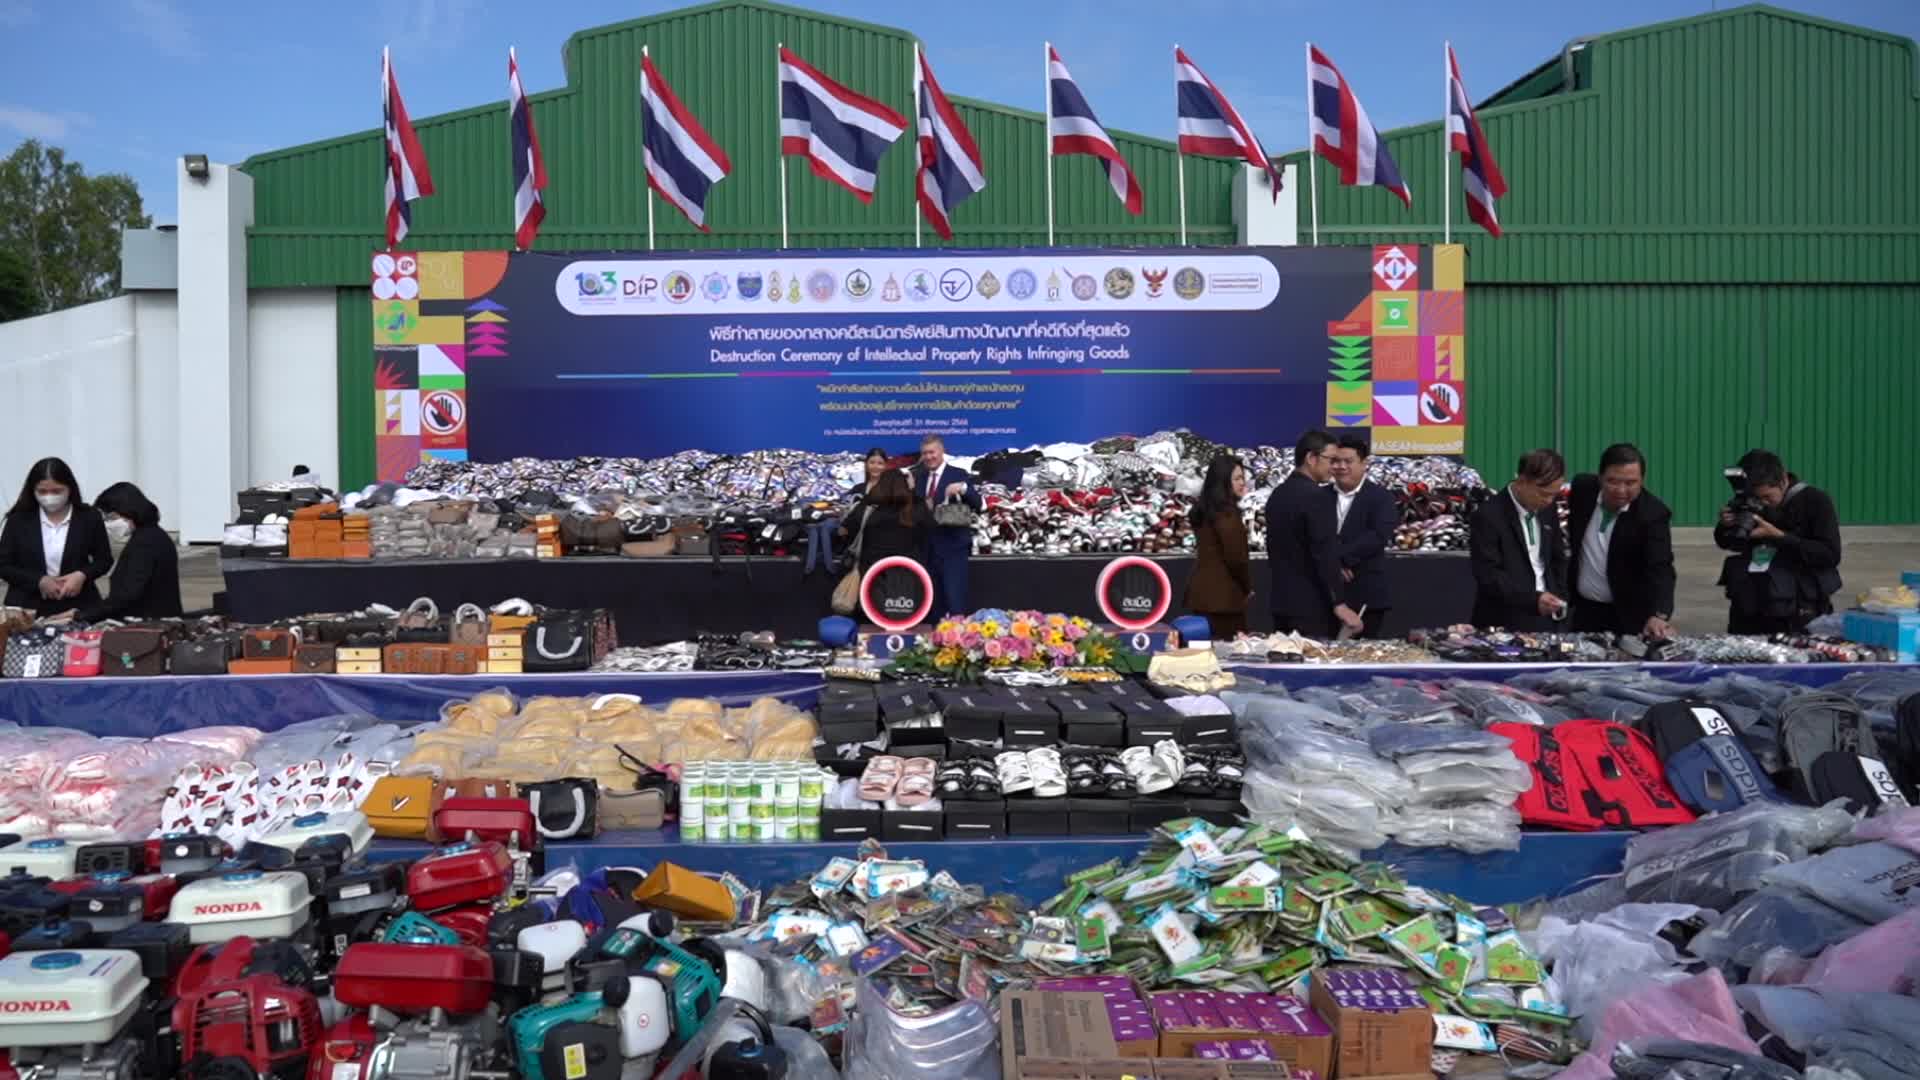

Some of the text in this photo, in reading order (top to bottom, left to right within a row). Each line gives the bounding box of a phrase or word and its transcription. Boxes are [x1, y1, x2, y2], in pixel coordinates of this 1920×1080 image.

[710, 345, 1130, 365] Destruction Ceremony of Intellectual Property Rights Infringing Goods
